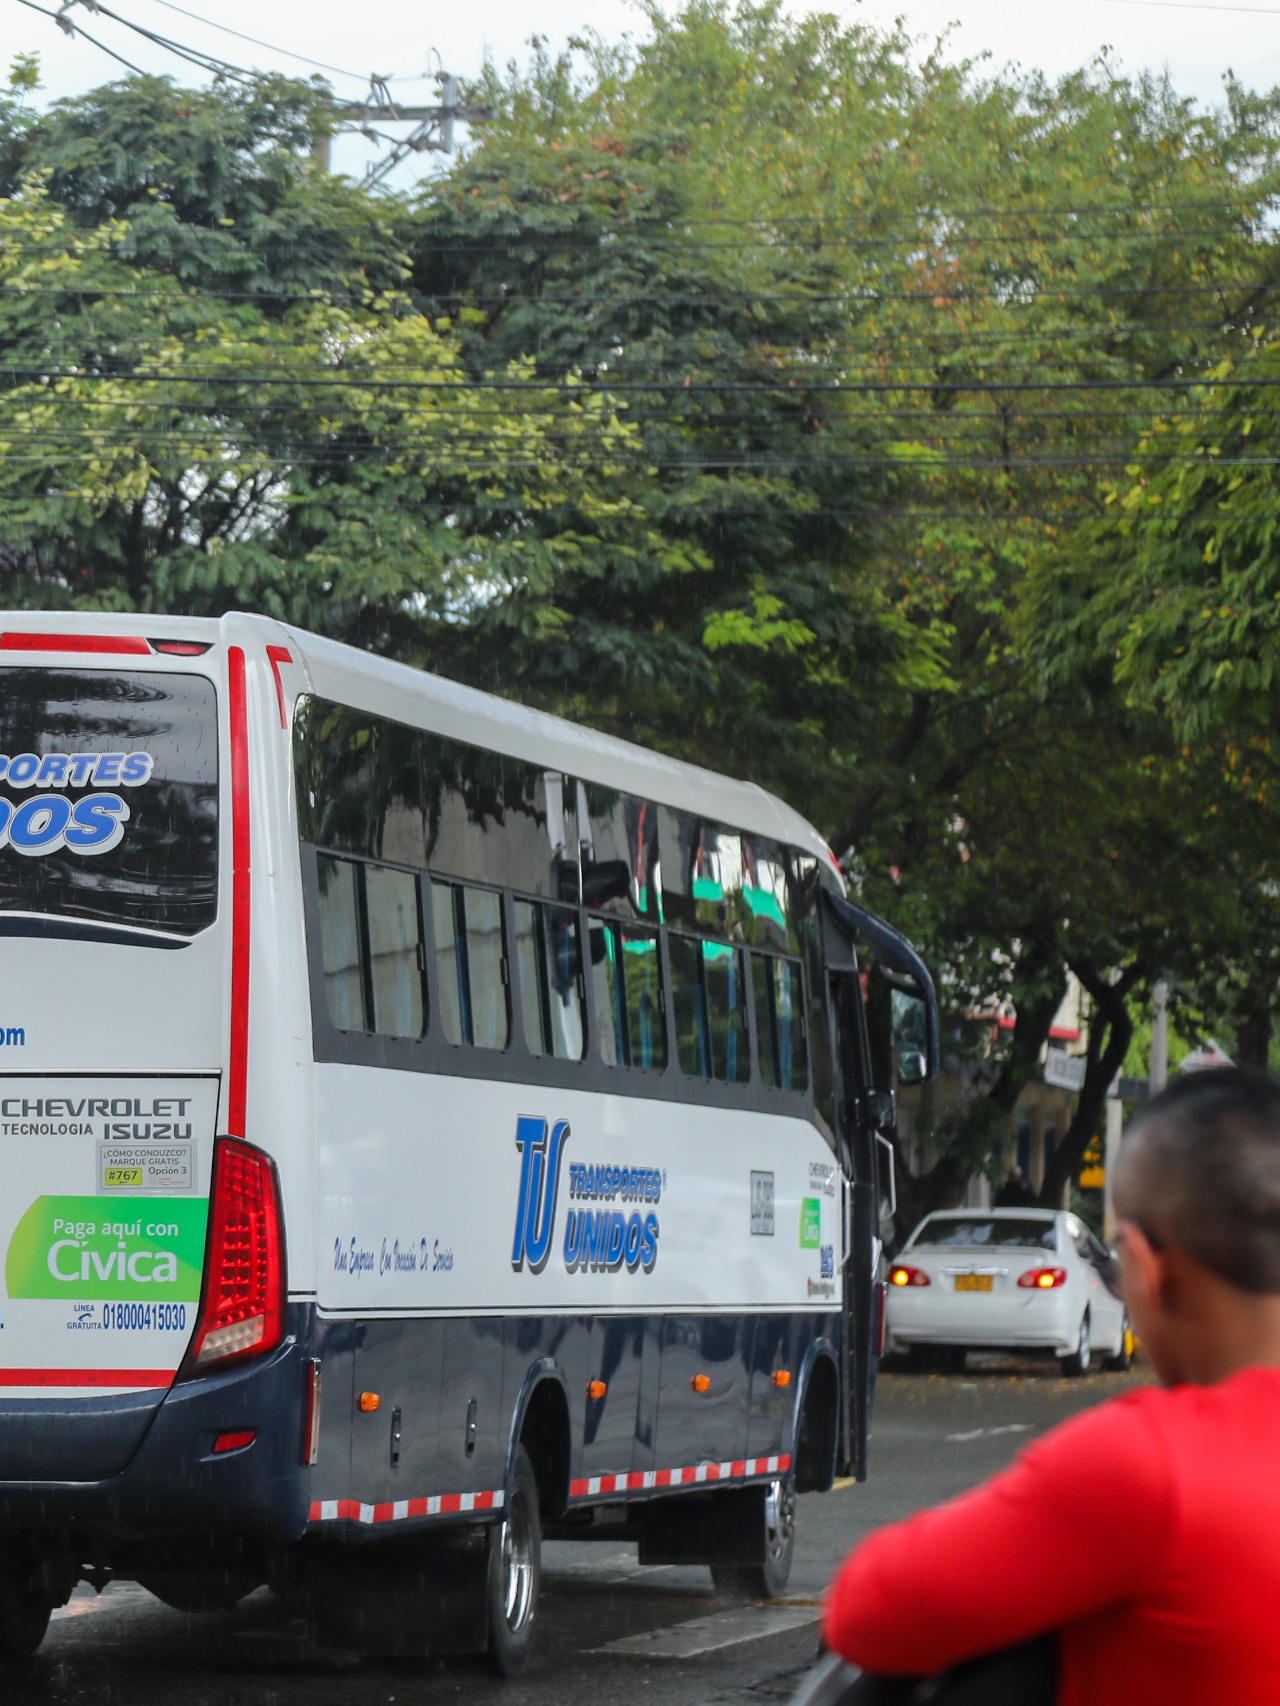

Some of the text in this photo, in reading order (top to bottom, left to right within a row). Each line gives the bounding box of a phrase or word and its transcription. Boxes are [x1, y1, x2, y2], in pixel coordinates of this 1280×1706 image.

[1, 1098, 192, 1118] CHEVROLET
[2, 1123, 192, 1140] TECNOLOGIA ISUZU
[103, 1148, 187, 1159] ¿CÓMO CONDUZCO?
[110, 1158, 147, 1166] MARQUE
[108, 1170, 138, 1181] #767
[148, 1166, 187, 1176] Opción 3
[569, 1162, 662, 1204] TRANSPORTES
[53, 1218, 179, 1239] Paga aquí con
[563, 1208, 659, 1274] UNIDOS
[47, 1239, 178, 1283] Cívica
[73, 1302, 96, 1312] LÍNEA
[66, 1321, 103, 1330] GRATUITA
[103, 1303, 186, 1331] 018000415030
